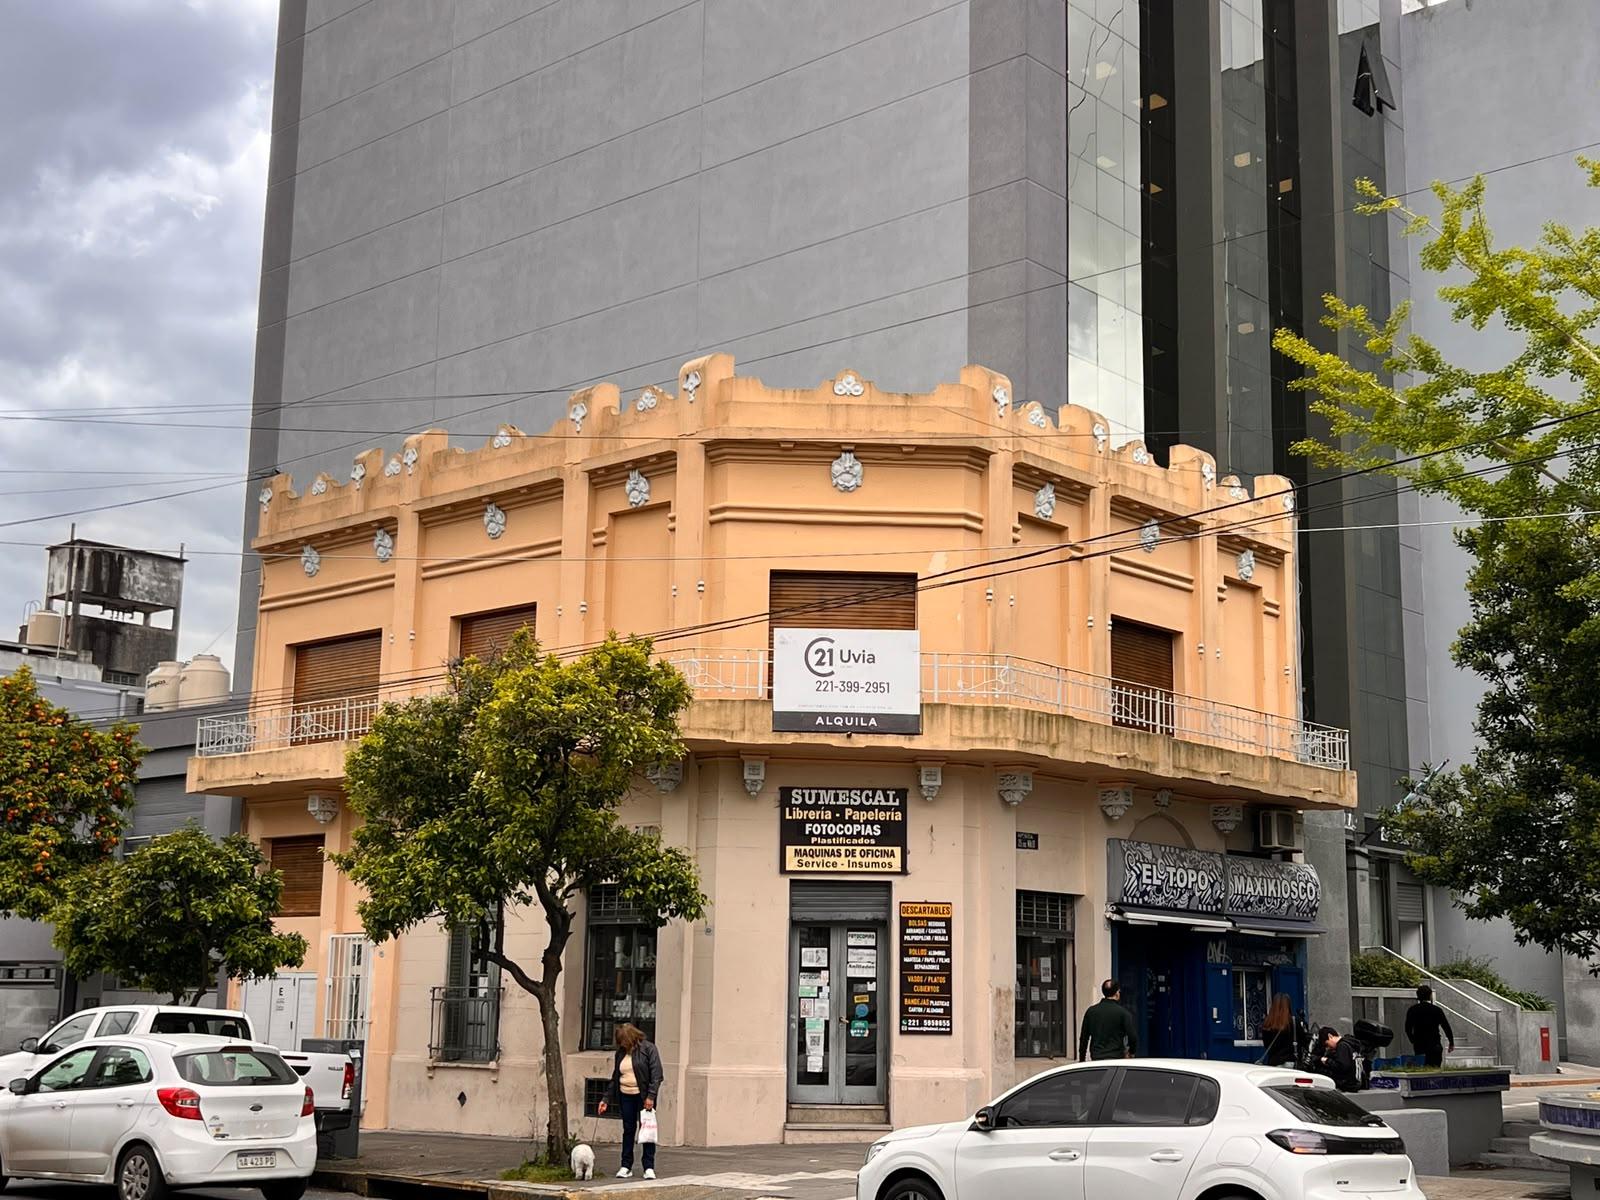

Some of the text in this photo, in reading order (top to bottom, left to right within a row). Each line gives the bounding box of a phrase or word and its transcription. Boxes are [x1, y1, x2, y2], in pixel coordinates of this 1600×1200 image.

[840, 649, 876, 664] Uvia
[815, 680, 890, 694] 221-399-2951
[815, 716, 878, 727] ALQUILA
[791, 788, 900, 806] SUMESCAL
[785, 806, 832, 820] Librería
[844, 807, 902, 823] Papelería
[805, 823, 881, 836] FOTOCOPIAS
[811, 836, 876, 845] Plastificados
[794, 848, 896, 859] MAQUINAS DE OFICINA
[797, 858, 838, 869] Service
[847, 859, 893, 869] Insumos
[1142, 863, 1209, 891] EL TOPO
[1234, 874, 1316, 901] MAXIKIOSCO
[901, 905, 951, 915] DESCARTABLES
